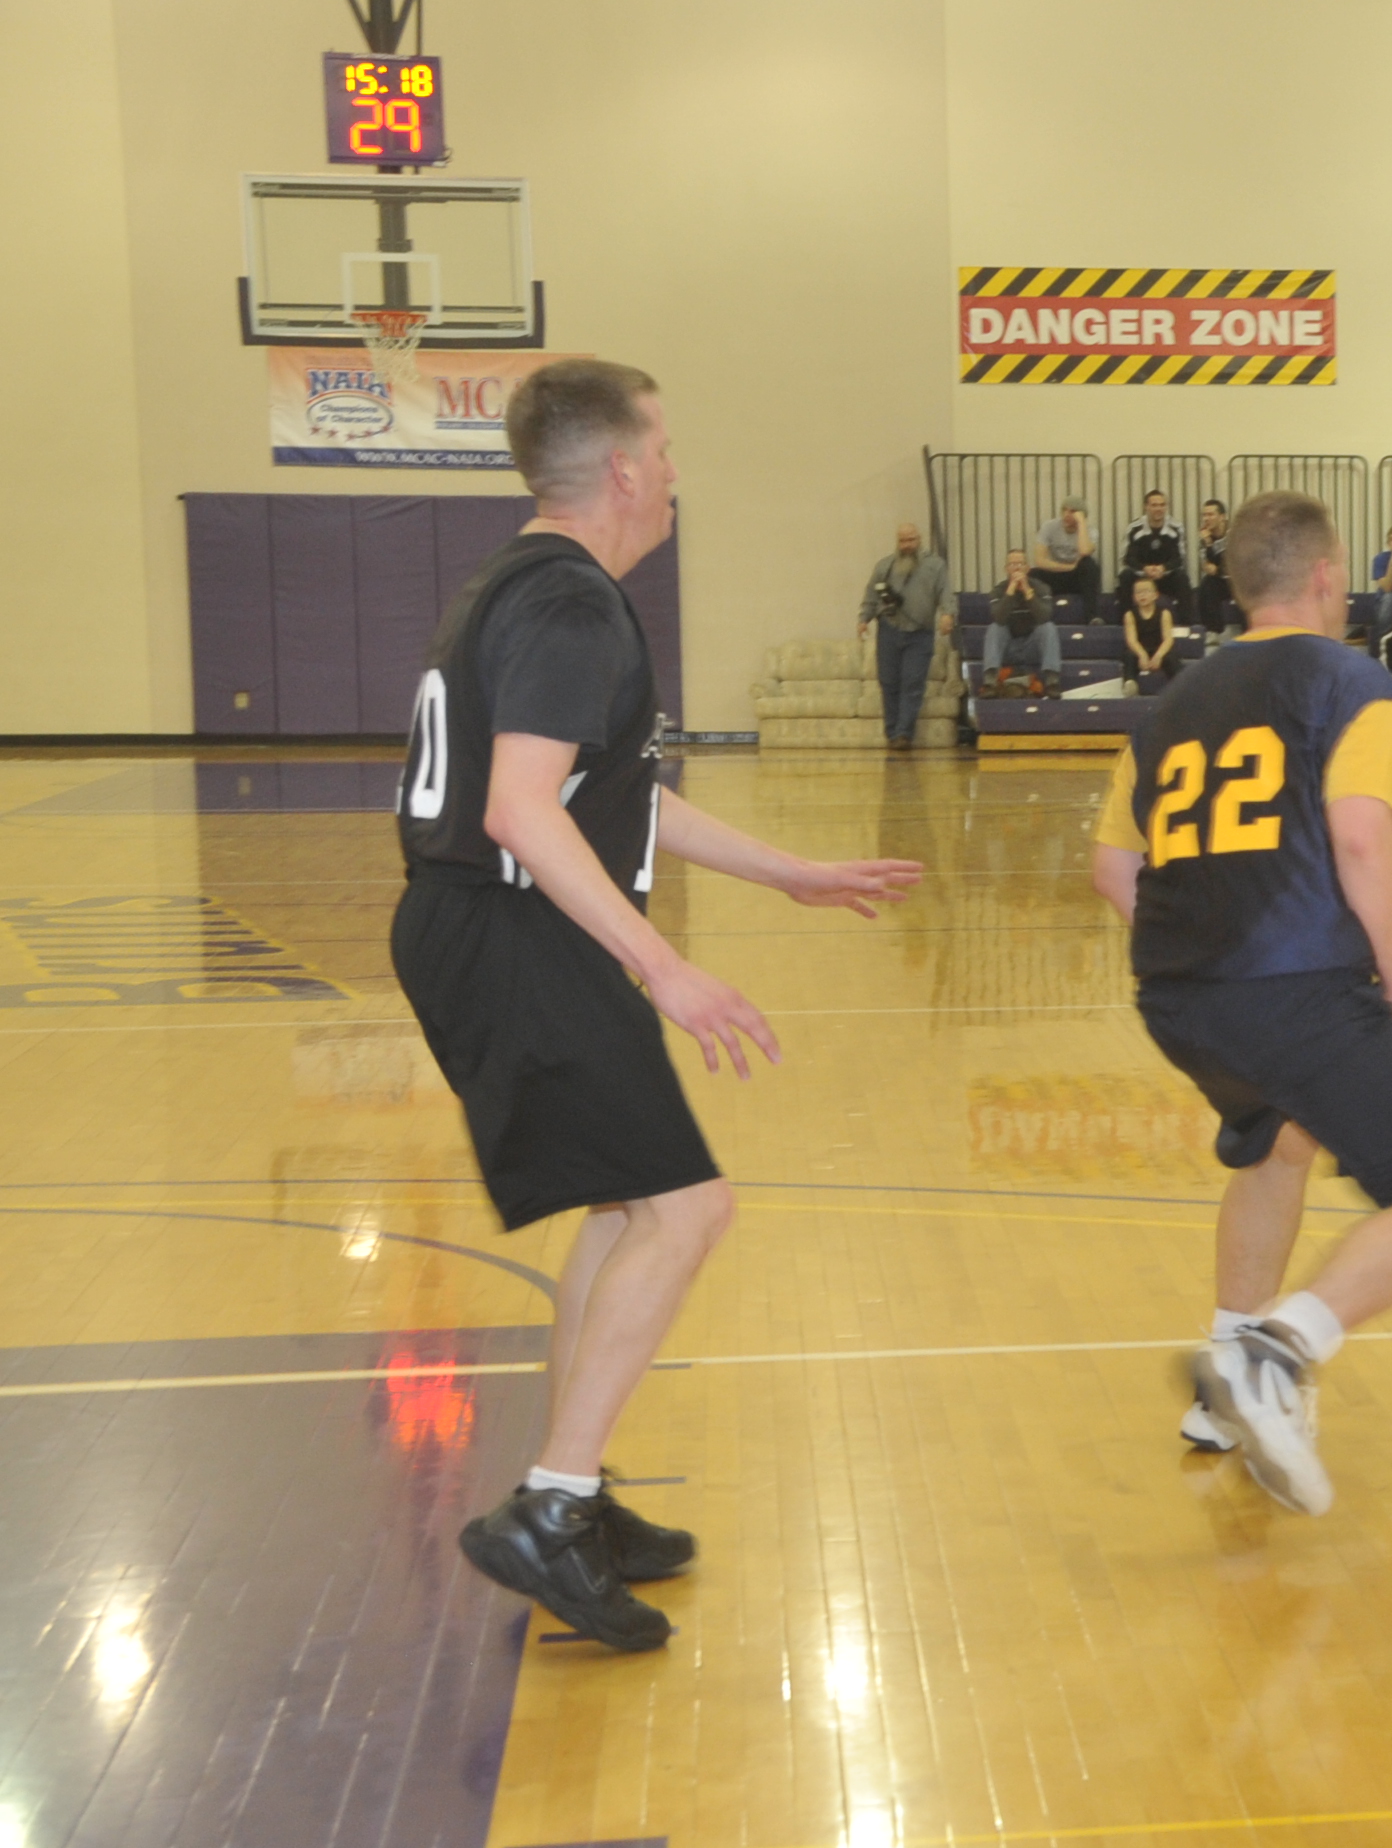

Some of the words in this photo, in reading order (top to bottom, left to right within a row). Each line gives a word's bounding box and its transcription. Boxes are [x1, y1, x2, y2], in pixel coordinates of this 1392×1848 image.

[345, 62, 434, 97] 15:18
[349, 96, 422, 155] 29
[967, 307, 1177, 346] DANGER
[1189, 309, 1324, 347] ZONE
[435, 376, 524, 420] MC
[1148, 725, 1286, 869] 22
